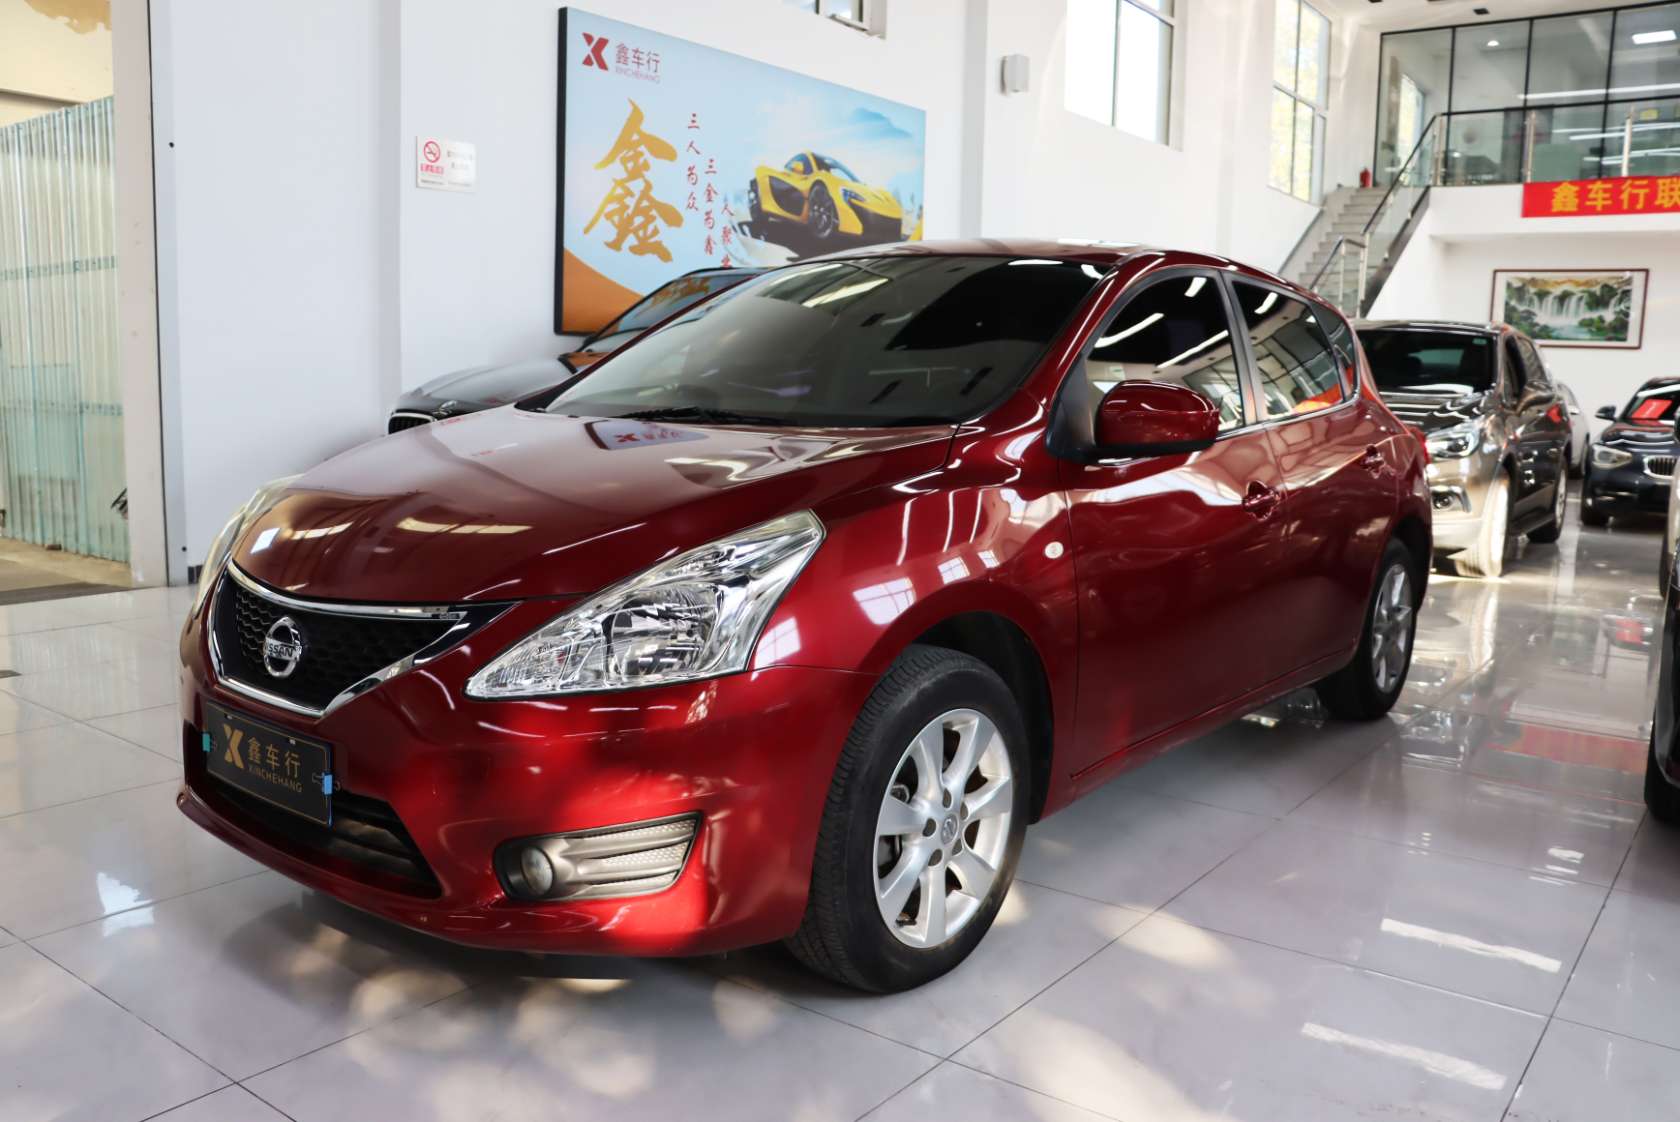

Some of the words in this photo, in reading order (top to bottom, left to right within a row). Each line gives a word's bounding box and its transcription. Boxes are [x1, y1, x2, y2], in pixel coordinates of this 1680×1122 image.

[615, 43, 661, 72] 鑫车行
[248, 737, 301, 778] 鑫车行
